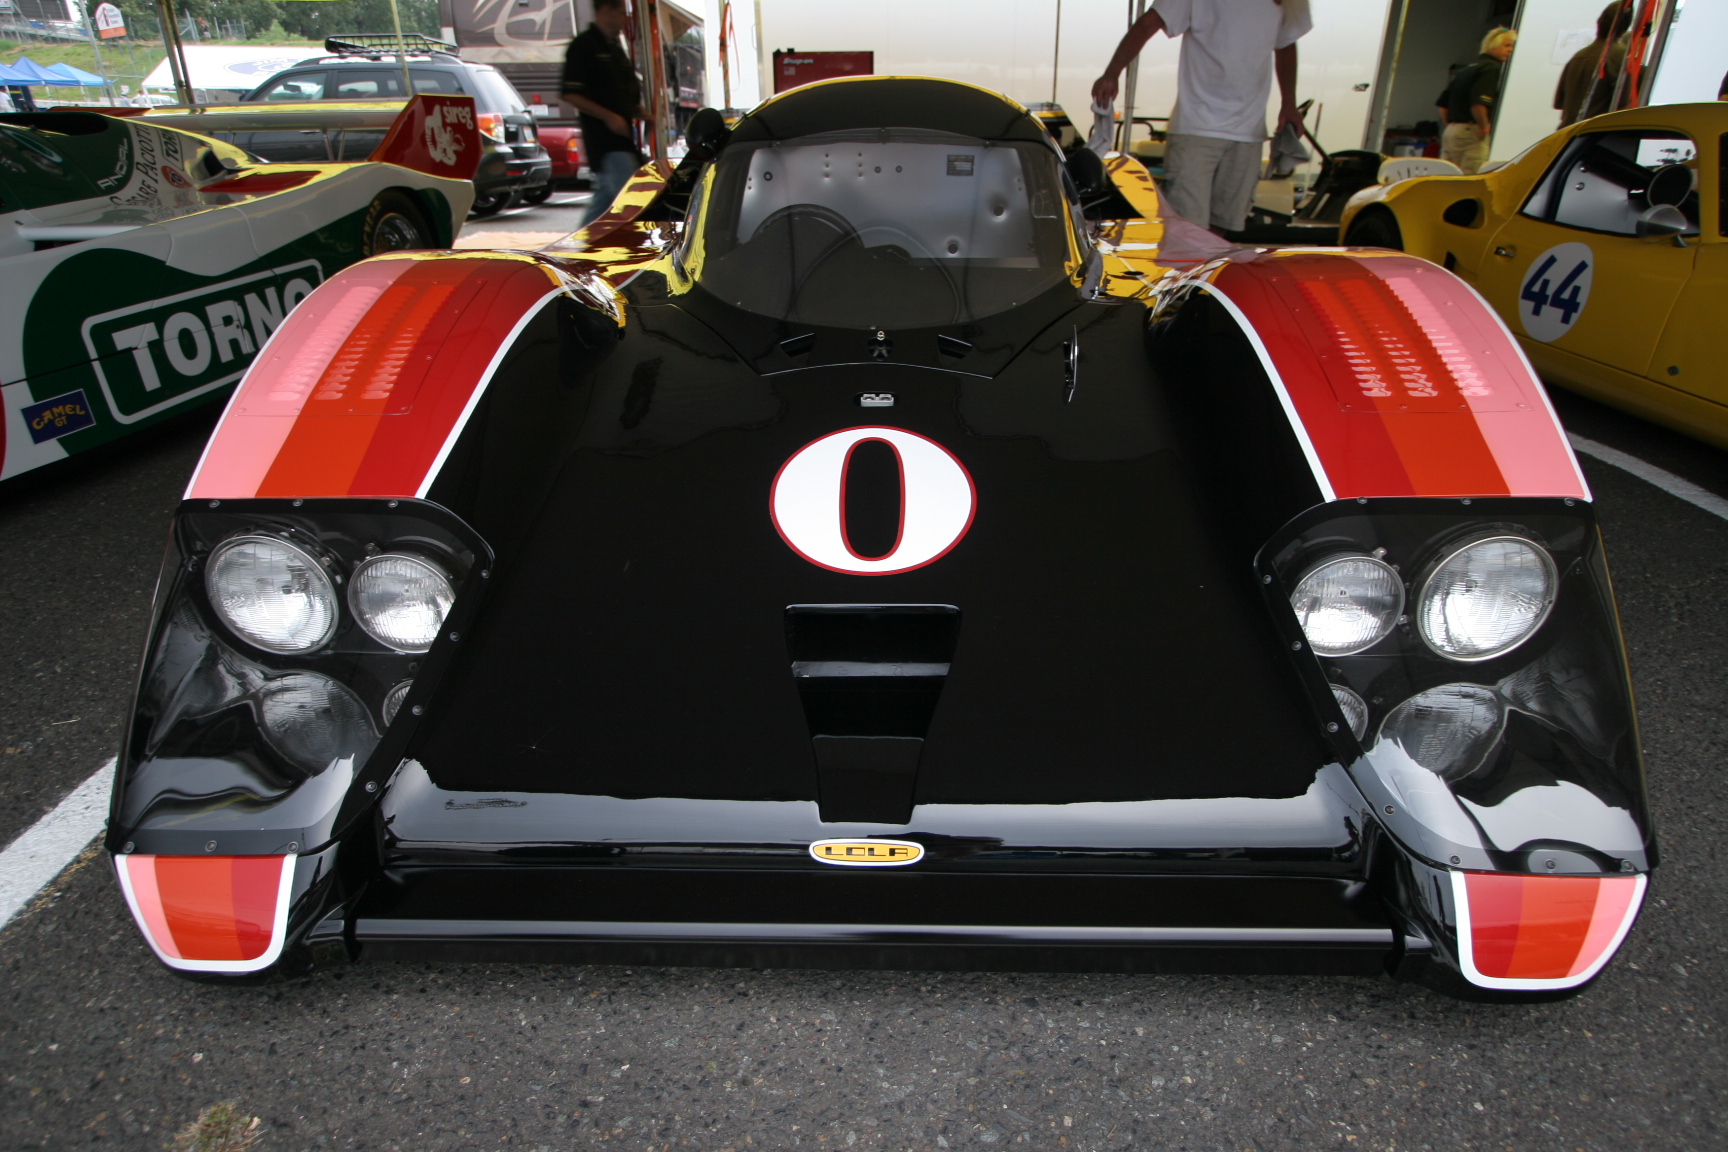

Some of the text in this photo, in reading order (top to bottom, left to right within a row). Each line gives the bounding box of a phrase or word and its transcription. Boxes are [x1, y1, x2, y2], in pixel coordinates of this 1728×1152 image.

[442, 100, 474, 130] sireg
[1520, 254, 1589, 325] 44
[32, 404, 86, 430] CAMEL
[54, 416, 68, 427] GT
[839, 437, 906, 561] 0
[825, 846, 909, 857] LOLA
